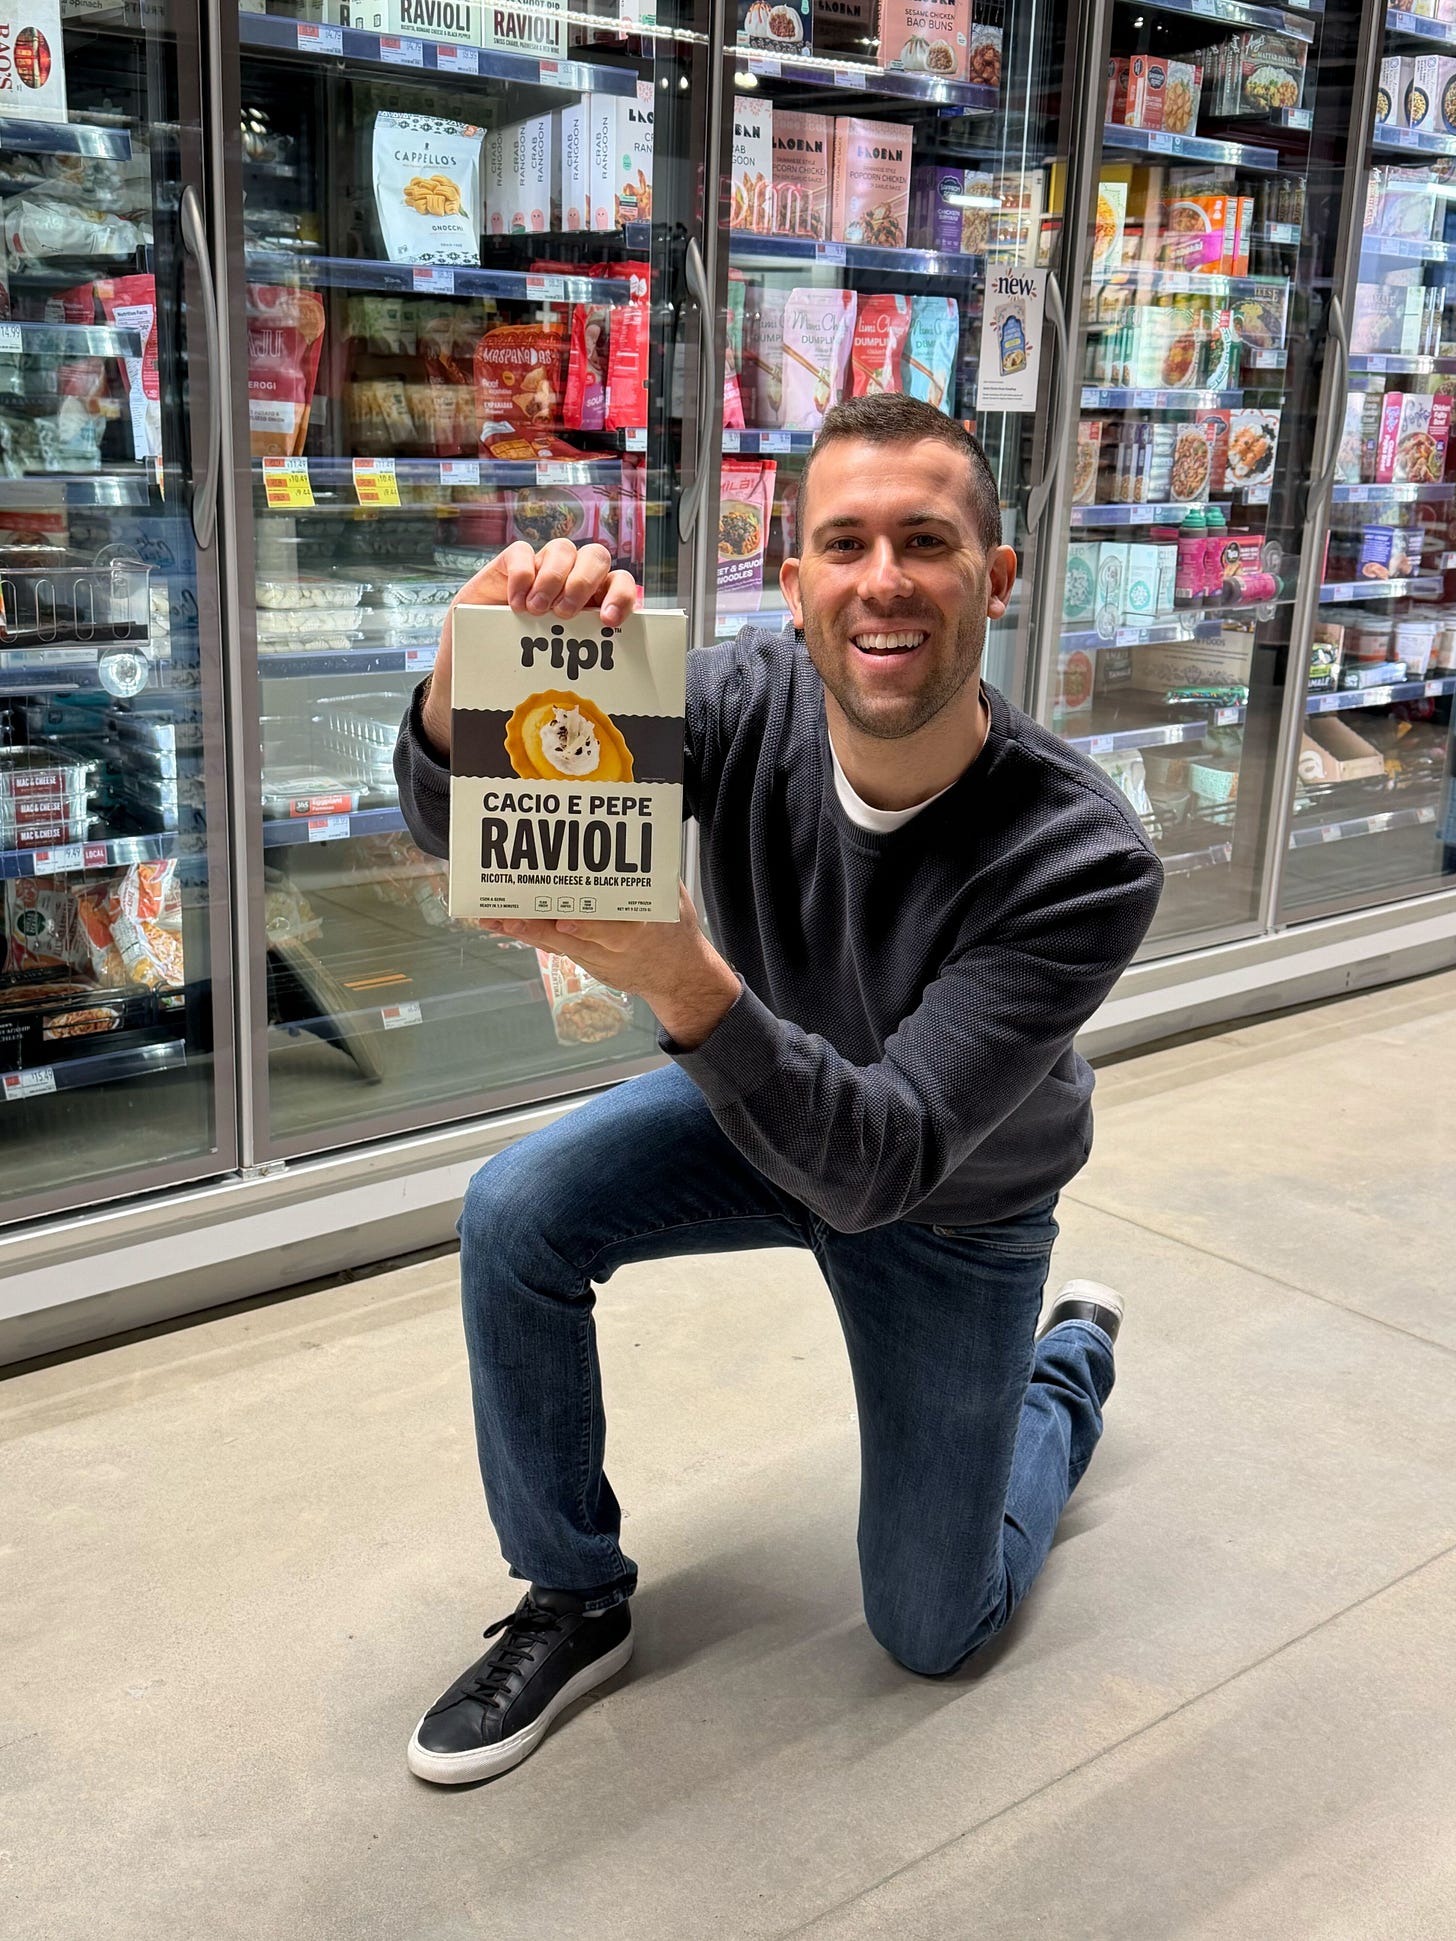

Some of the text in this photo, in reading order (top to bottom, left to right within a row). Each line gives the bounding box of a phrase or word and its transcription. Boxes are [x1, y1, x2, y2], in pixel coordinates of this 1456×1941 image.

[400, 0, 471, 33] RAVIOLI
[906, 17, 953, 31] BAO BUNS
[494, 9, 560, 46] RAVIOLI
[394, 150, 457, 166] CAPPELLO'S
[432, 224, 464, 232] GNOCCHI
[998, 275, 1034, 297] new
[483, 346, 553, 366] MASPANADAS
[520, 624, 614, 681] ripi
[16, 778, 29, 787] MAC
[35, 775, 57, 786] CHEESE
[20, 804, 34, 813] MAC
[39, 801, 61, 812] CHEESE
[483, 791, 653, 817] CACIO E PEPE
[20, 831, 34, 841] MAC
[39, 828, 61, 839] CHEESE
[481, 817, 653, 874] RAVIOLI
[85, 849, 104, 860] LOCAL
[481, 873, 652, 888] RICOTTA, ROMANO CHEESE & BLACK PEPPER
